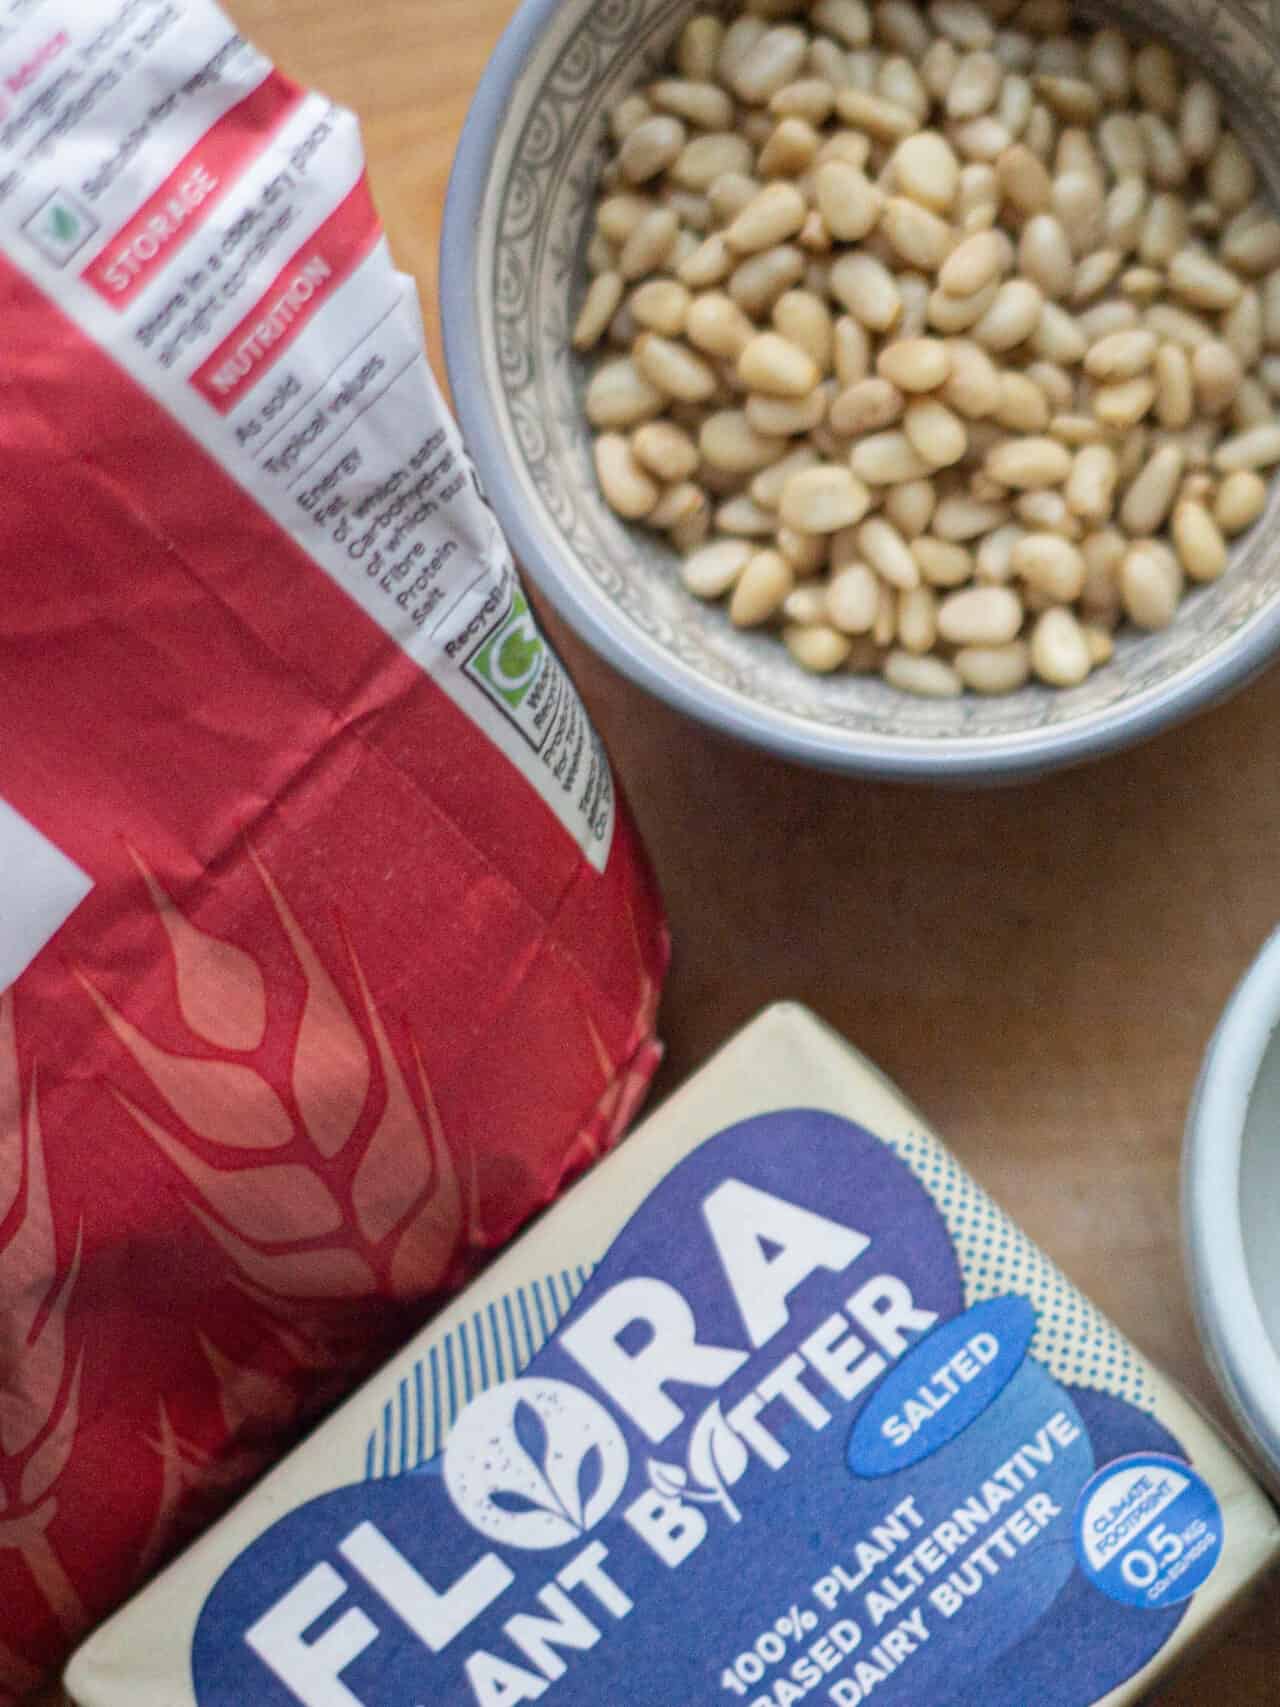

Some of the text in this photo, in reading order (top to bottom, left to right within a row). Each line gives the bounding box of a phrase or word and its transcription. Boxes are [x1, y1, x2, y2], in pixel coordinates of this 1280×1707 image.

[104, 163, 218, 292] STORAGE
[211, 256, 332, 392] NUTRITION
[235, 373, 301, 447] As sold
[262, 353, 385, 473] Typical values
[297, 447, 362, 511] Energy
[313, 495, 350, 527] Fat
[333, 428, 447, 543] of which satu
[367, 550, 384, 577] of
[386, 501, 438, 552] which
[380, 541, 426, 594] Fibre
[396, 540, 459, 610] Protein
[411, 587, 447, 626] Salt
[244, 1178, 872, 1707] FLORA
[881, 1332, 999, 1448] SALTED
[864, 1412, 1081, 1627] ALTERNATIVE
[1093, 1474, 1153, 1534] CLIMATE
[1096, 1478, 1173, 1556] FOOTPRINT
[463, 1540, 634, 1707] ANT
[720, 1495, 926, 1697] 100% PLANT
[829, 1491, 1063, 1707] DAIRY BUTTER
